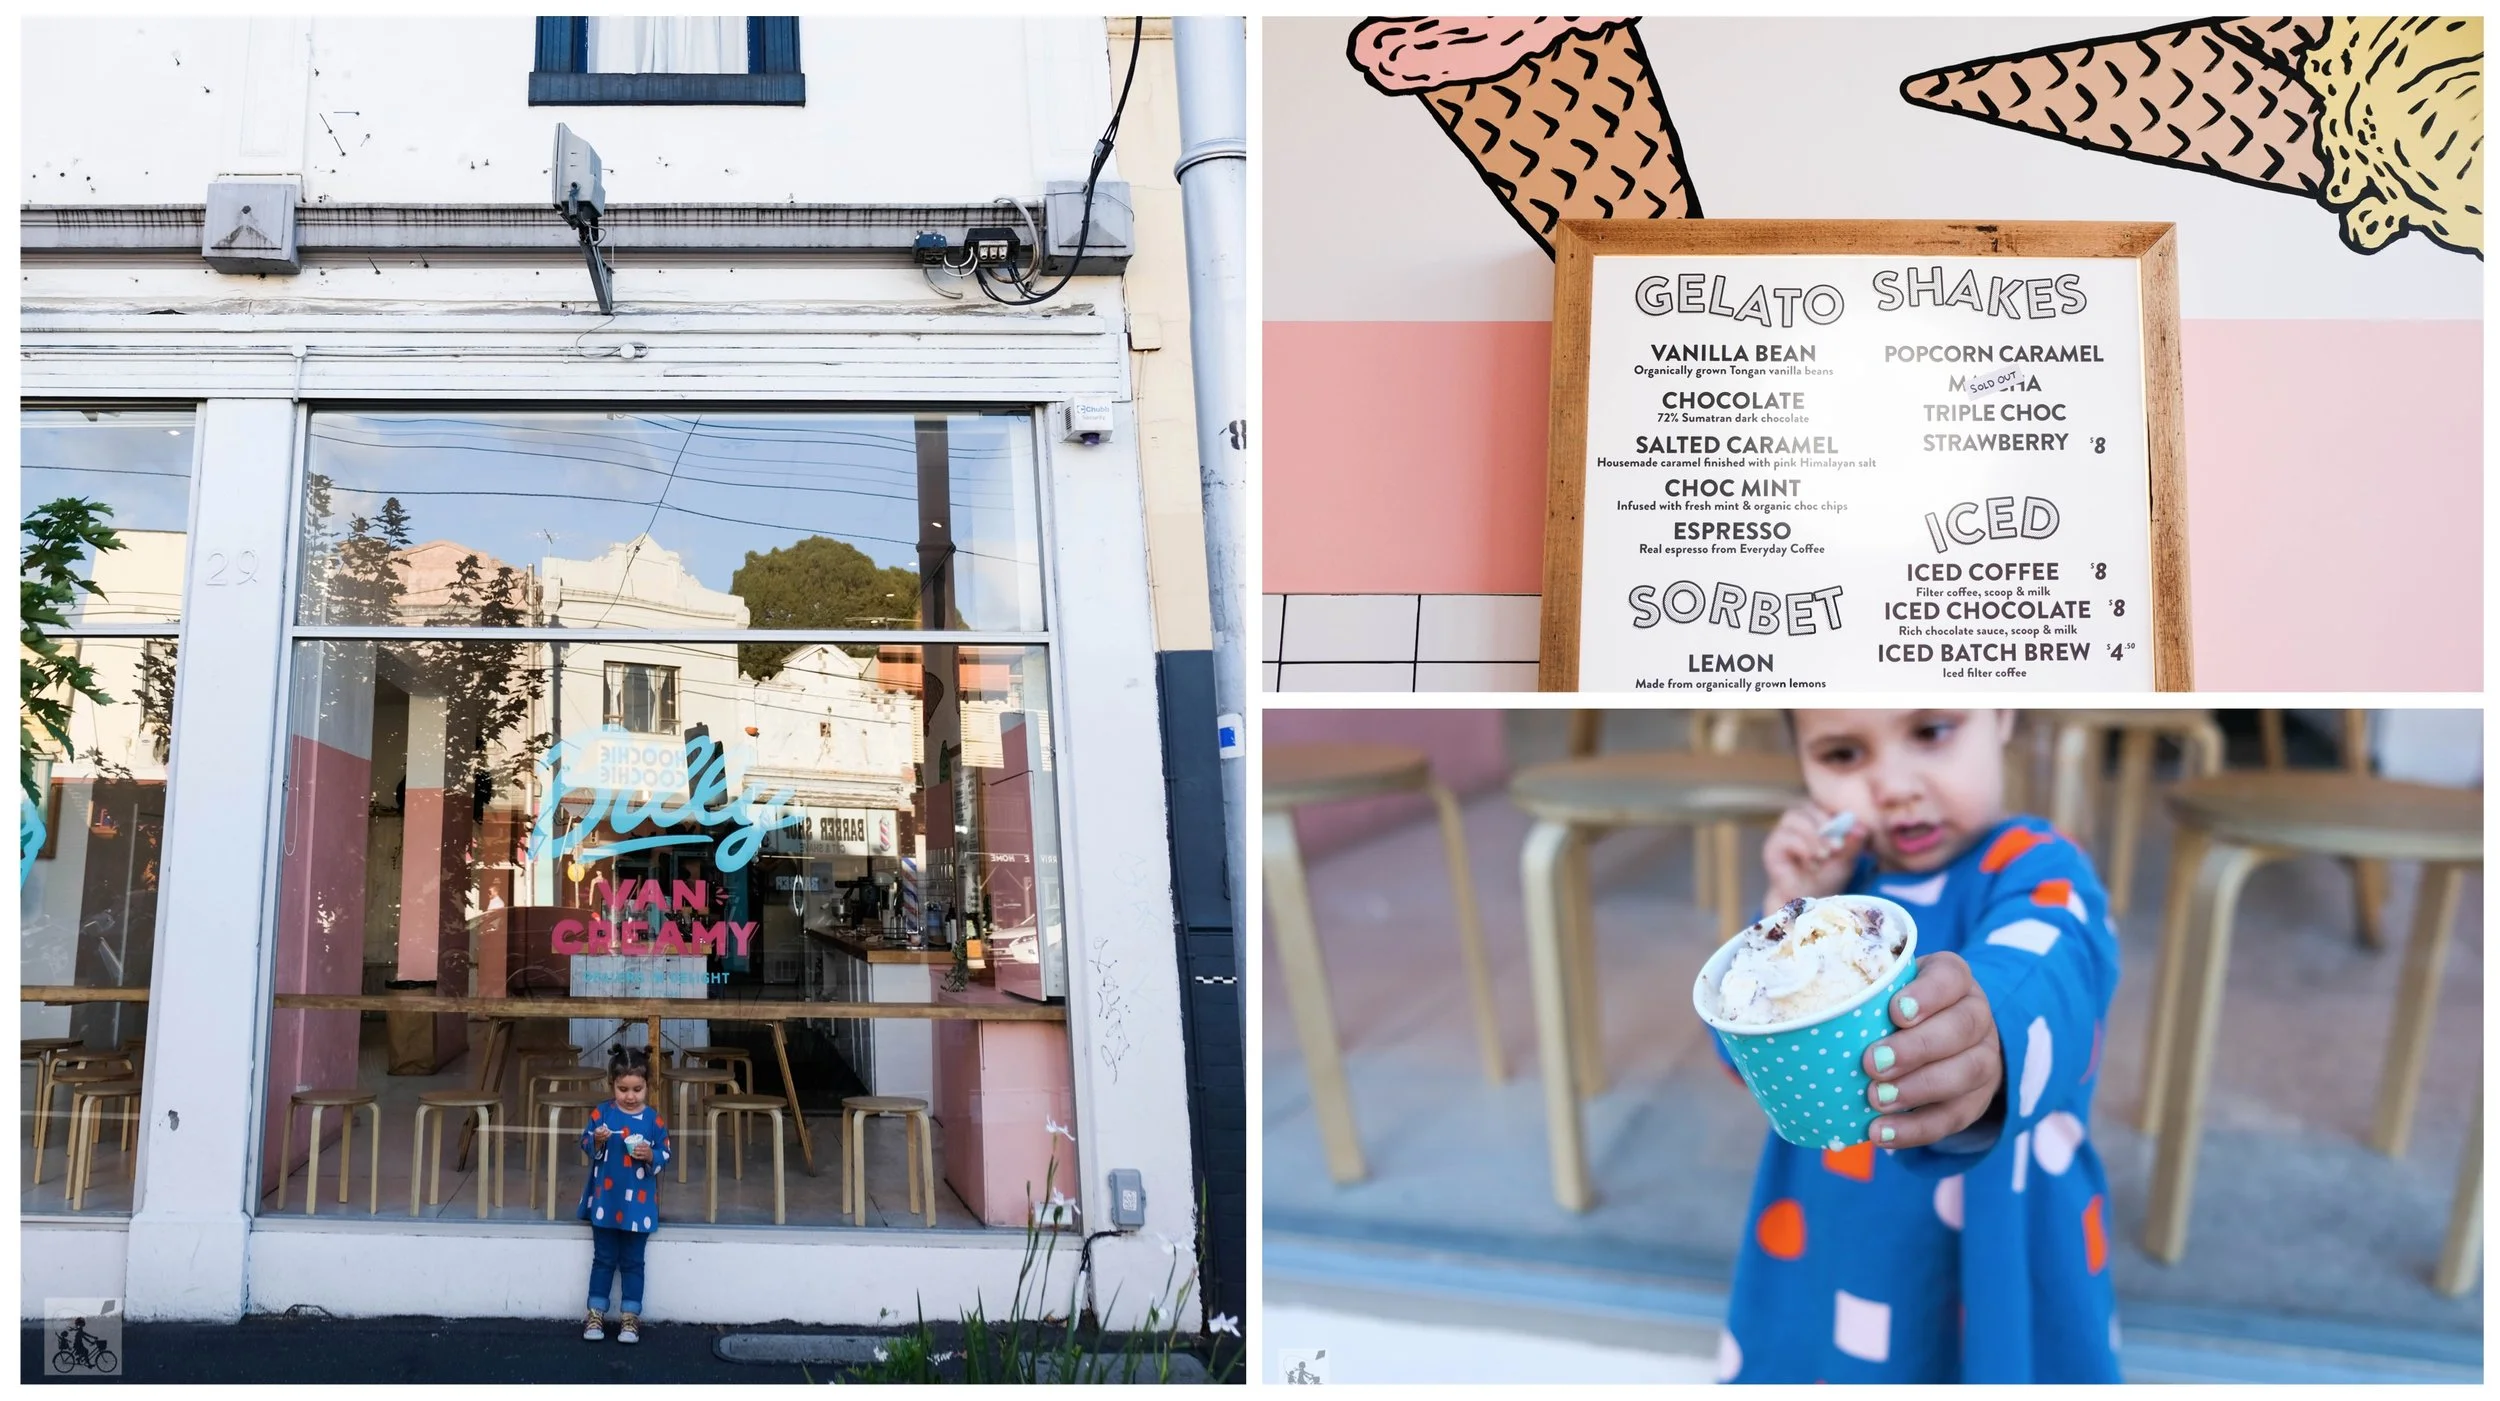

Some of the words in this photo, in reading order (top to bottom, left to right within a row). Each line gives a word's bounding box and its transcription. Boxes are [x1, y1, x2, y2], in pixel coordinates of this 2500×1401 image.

[1635, 273, 1844, 328] GELATO
[1873, 266, 2087, 320] SHAKES
[1651, 344, 1749, 361] VANILLA
[1756, 345, 1815, 362] BEAN
[1885, 345, 1993, 362] POPCORN
[1999, 345, 2104, 362] CARAMEL
[1634, 365, 1693, 378] Organically
[1696, 368, 1726, 378] grown
[1729, 365, 1766, 378] Tongan
[1769, 365, 1802, 375] vanilla
[1805, 366, 1834, 375] beans
[1970, 379, 1995, 393] SOLD
[1997, 371, 2016, 384] OUT
[1662, 392, 1804, 409] CHOCOLATE
[1658, 413, 1679, 422] 72%
[1682, 413, 1732, 422] Sumatran
[1735, 413, 1758, 422] dark
[1761, 413, 1809, 423] chocolate
[1923, 404, 1995, 421] TRIPLE
[2000, 404, 2066, 421] CHOC
[1636, 436, 1720, 453] SALTED
[1727, 436, 1839, 454] CARAMEL
[1923, 433, 2069, 451] STRAWBERRY
[2090, 437, 2106, 454] $8
[1597, 457, 1658, 467] Housemade
[1661, 457, 1700, 467] caramel
[1704, 457, 1745, 467] finished
[1748, 457, 1770, 467] with
[1774, 458, 1796, 471] pink
[1800, 457, 1855, 471] Himalayan
[1856, 458, 1876, 467] salt
[1665, 479, 1735, 497] CHOC
[1741, 479, 1801, 497] MINT
[1617, 500, 1656, 510] Infused
[1659, 501, 1682, 510] with
[1685, 501, 1711, 510] fresh
[1715, 501, 1739, 510] mint
[1743, 501, 1751, 510] &
[1754, 501, 1791, 514] organic
[1794, 501, 1818, 510] choc
[1821, 501, 1848, 514] chips
[1674, 522, 1791, 540] ESPRESSO
[1924, 496, 2059, 553] ICED
[1640, 544, 1662, 553] Real
[1665, 547, 1708, 557] espresso
[1711, 544, 1736, 553] from
[1740, 544, 1787, 557] Everyday
[1790, 544, 1825, 553] Coffee
[206, 550, 258, 586] 29
[1908, 564, 1962, 581] ICED
[1969, 563, 2059, 581] COFFEE
[2090, 563, 2107, 580] $8
[1916, 587, 1944, 597] Filter
[1947, 587, 1981, 599] coffee,
[1984, 590, 2013, 600] scoop
[2016, 586, 2024, 596] &
[2028, 586, 2051, 596] milk
[1629, 580, 1844, 636] SORBET
[1885, 602, 1940, 620] ICED
[1947, 598, 2091, 619] CHOCOLATE
[2108, 599, 2125, 617] $8
[1899, 626, 1922, 635] Rich
[1925, 626, 1974, 635] chocolate
[1977, 629, 2008, 637] sauce,
[2011, 629, 2039, 638] scoop
[2043, 625, 2051, 634] &
[2054, 624, 2077, 634] milk
[1879, 644, 1933, 662] ICED
[1941, 643, 2016, 662] BATCH
[2025, 643, 2090, 661] BREW
[1689, 654, 1773, 672] LEMON
[1943, 668, 1964, 678] Iced
[1967, 668, 1992, 677] filter
[1995, 667, 2027, 677] coffee
[1635, 678, 1665, 688] Made
[1666, 678, 1693, 688] from
[1696, 678, 1752, 690] organically
[1755, 681, 1786, 690] grown
[1790, 678, 1826, 688] lemons
[600, 879, 709, 911] VAN
[552, 919, 760, 957] CREAMY
